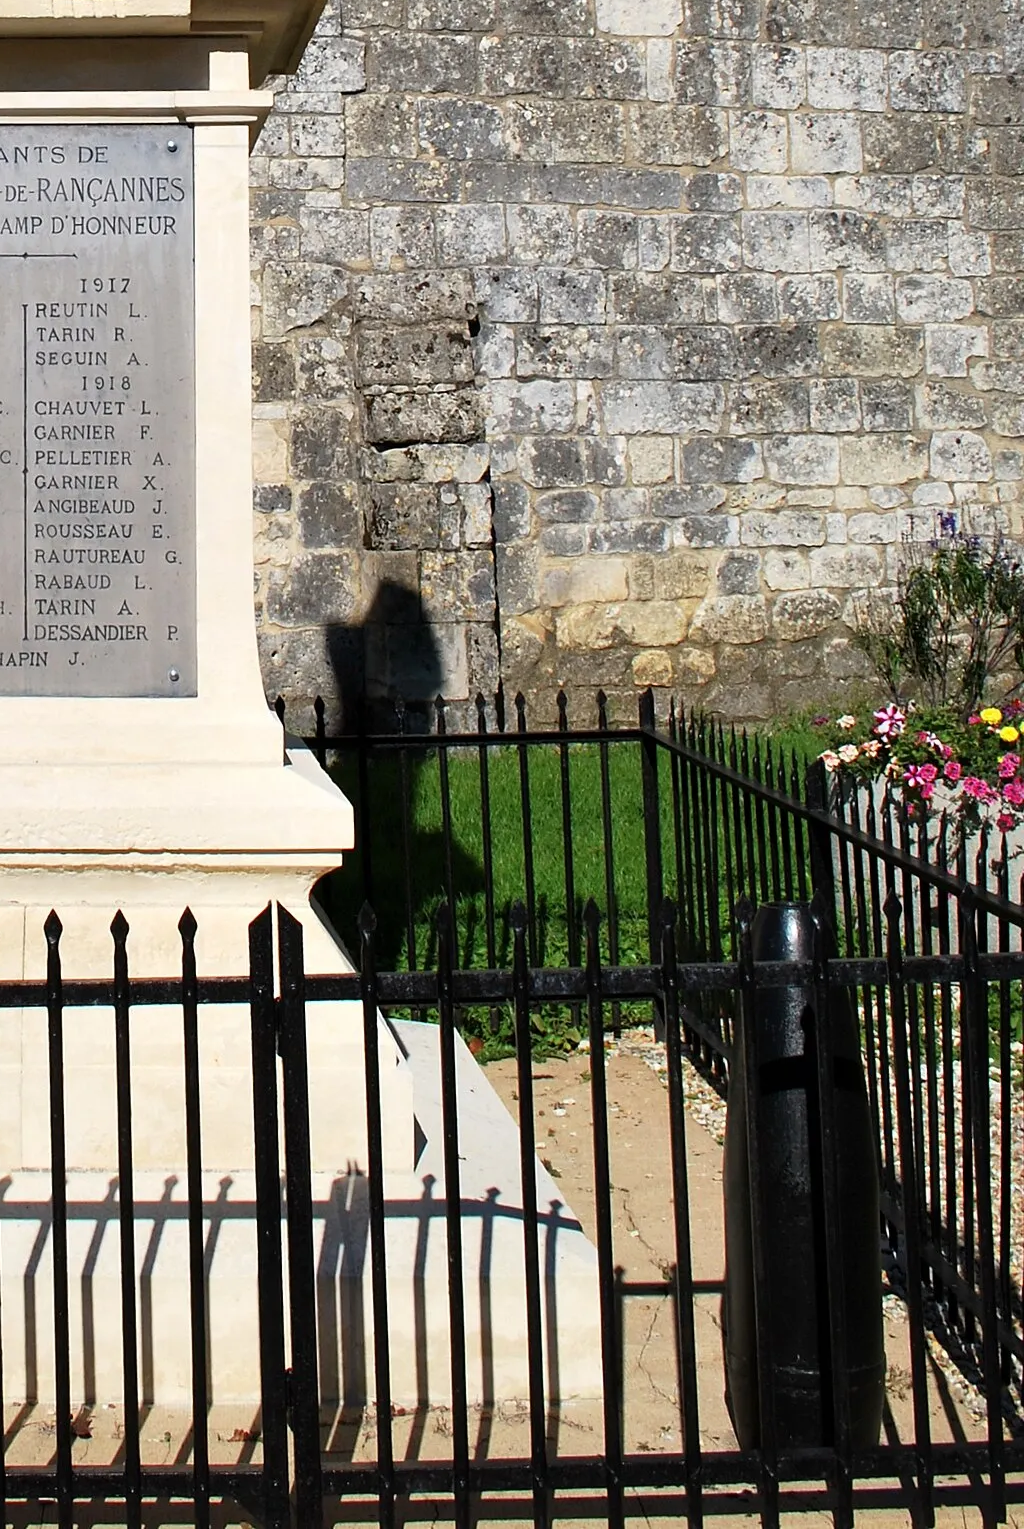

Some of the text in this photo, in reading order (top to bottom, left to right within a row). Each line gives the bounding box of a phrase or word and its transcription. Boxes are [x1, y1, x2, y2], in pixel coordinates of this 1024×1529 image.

[78, 146, 109, 164] DE
[52, 214, 177, 235] D'HONNEUR
[80, 278, 131, 293] 1917
[35, 303, 148, 318] REUTIN L.
[36, 327, 133, 342] TARIN R.
[35, 351, 149, 366] SEGUIN A.
[81, 376, 132, 391] 1918
[34, 400, 160, 416] CHAUVET L.
[34, 425, 153, 440] GARNIER F.
[0, 450, 19, 466] C.
[35, 450, 171, 466] PELLETIER A.
[34, 475, 165, 491] GARNIER X.
[33, 499, 167, 515] ANGIBEAUD J.
[34, 523, 170, 539] ROUSSEAU E.
[34, 549, 183, 565] RAUTUREAU G.
[34, 574, 153, 591] RABAUD L.
[34, 599, 140, 616] TARIN A.
[34, 624, 179, 641] DESSANDIER P.
[68, 651, 85, 666] J.
